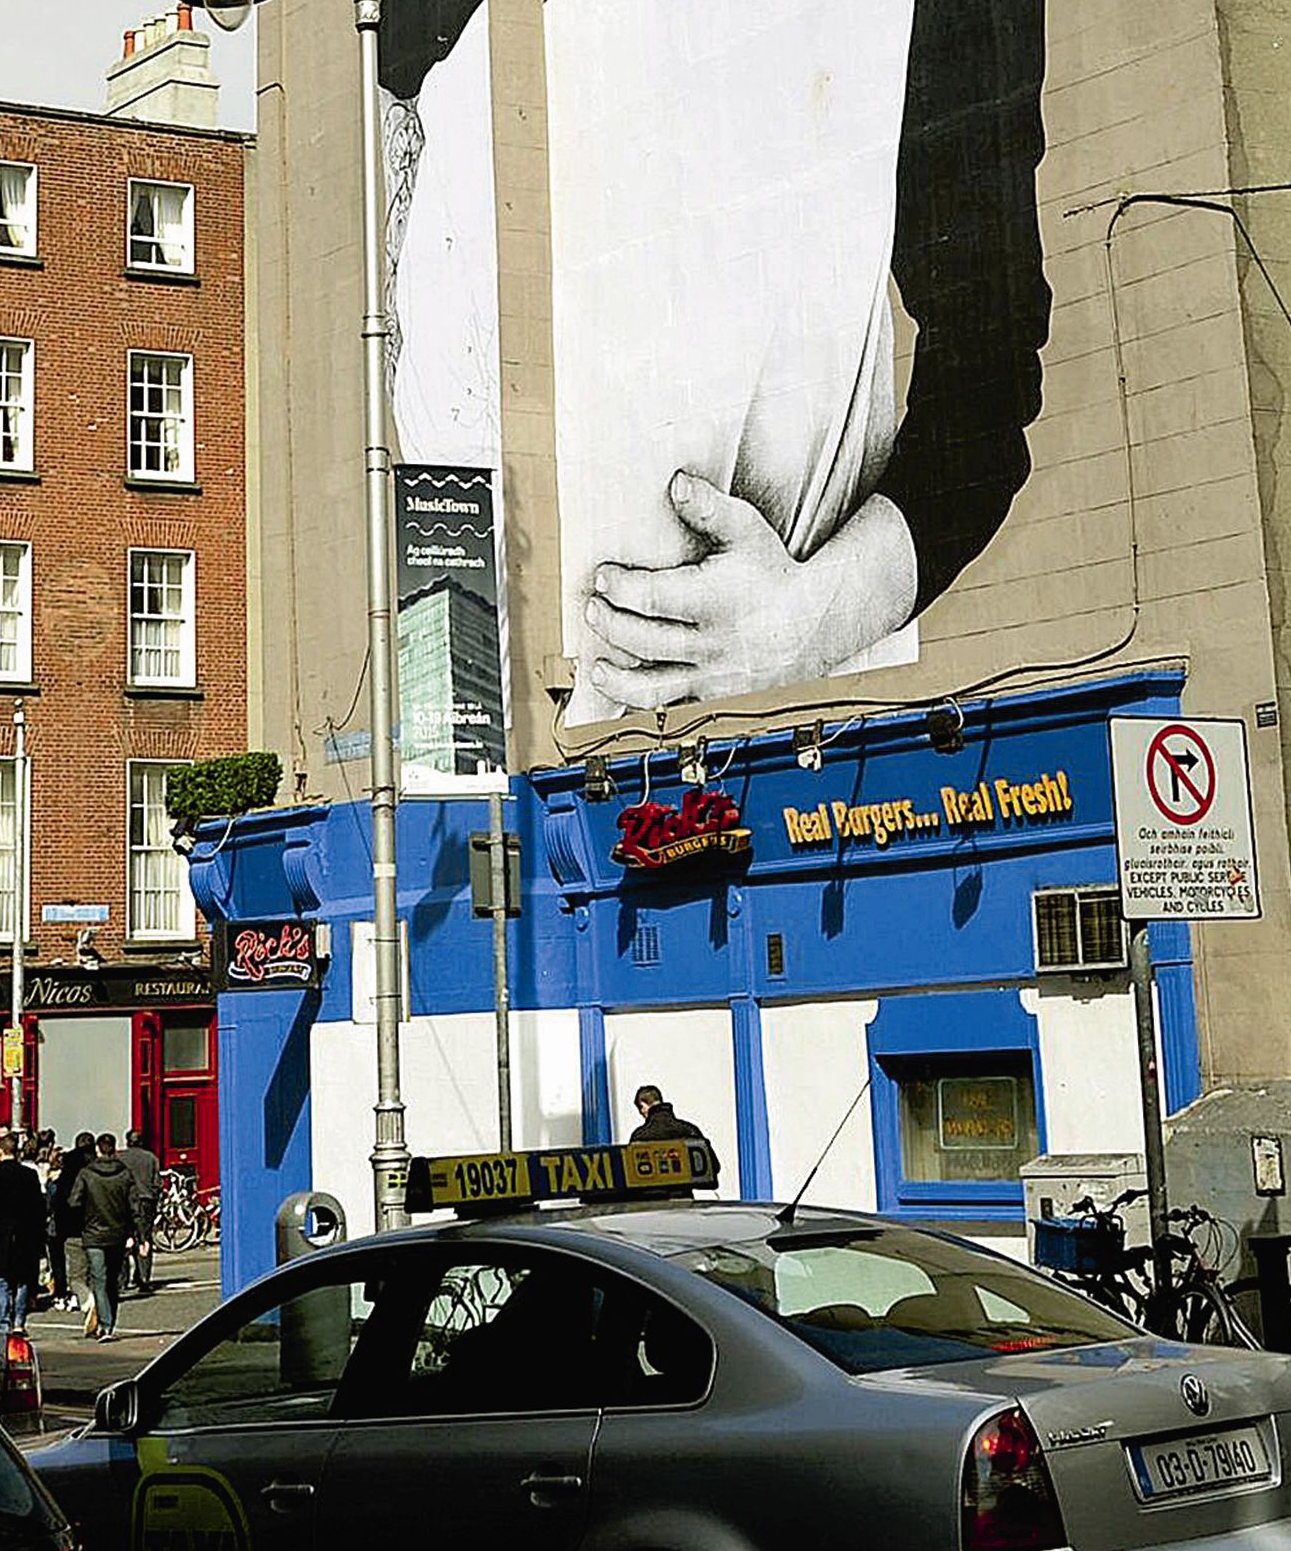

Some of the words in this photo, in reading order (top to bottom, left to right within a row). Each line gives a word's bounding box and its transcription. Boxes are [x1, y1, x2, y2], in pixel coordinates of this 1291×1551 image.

[783, 803, 832, 844] Real
[940, 782, 994, 825] Real
[995, 770, 1073, 818] Fresh!
[1130, 871, 1167, 884] EXCEPT
[1170, 871, 1205, 883] PUBLIC
[1163, 901, 1183, 912] AND
[24, 977, 93, 1007] Nicos
[456, 1158, 519, 1199] 19037
[540, 1152, 615, 1193] TAXI
